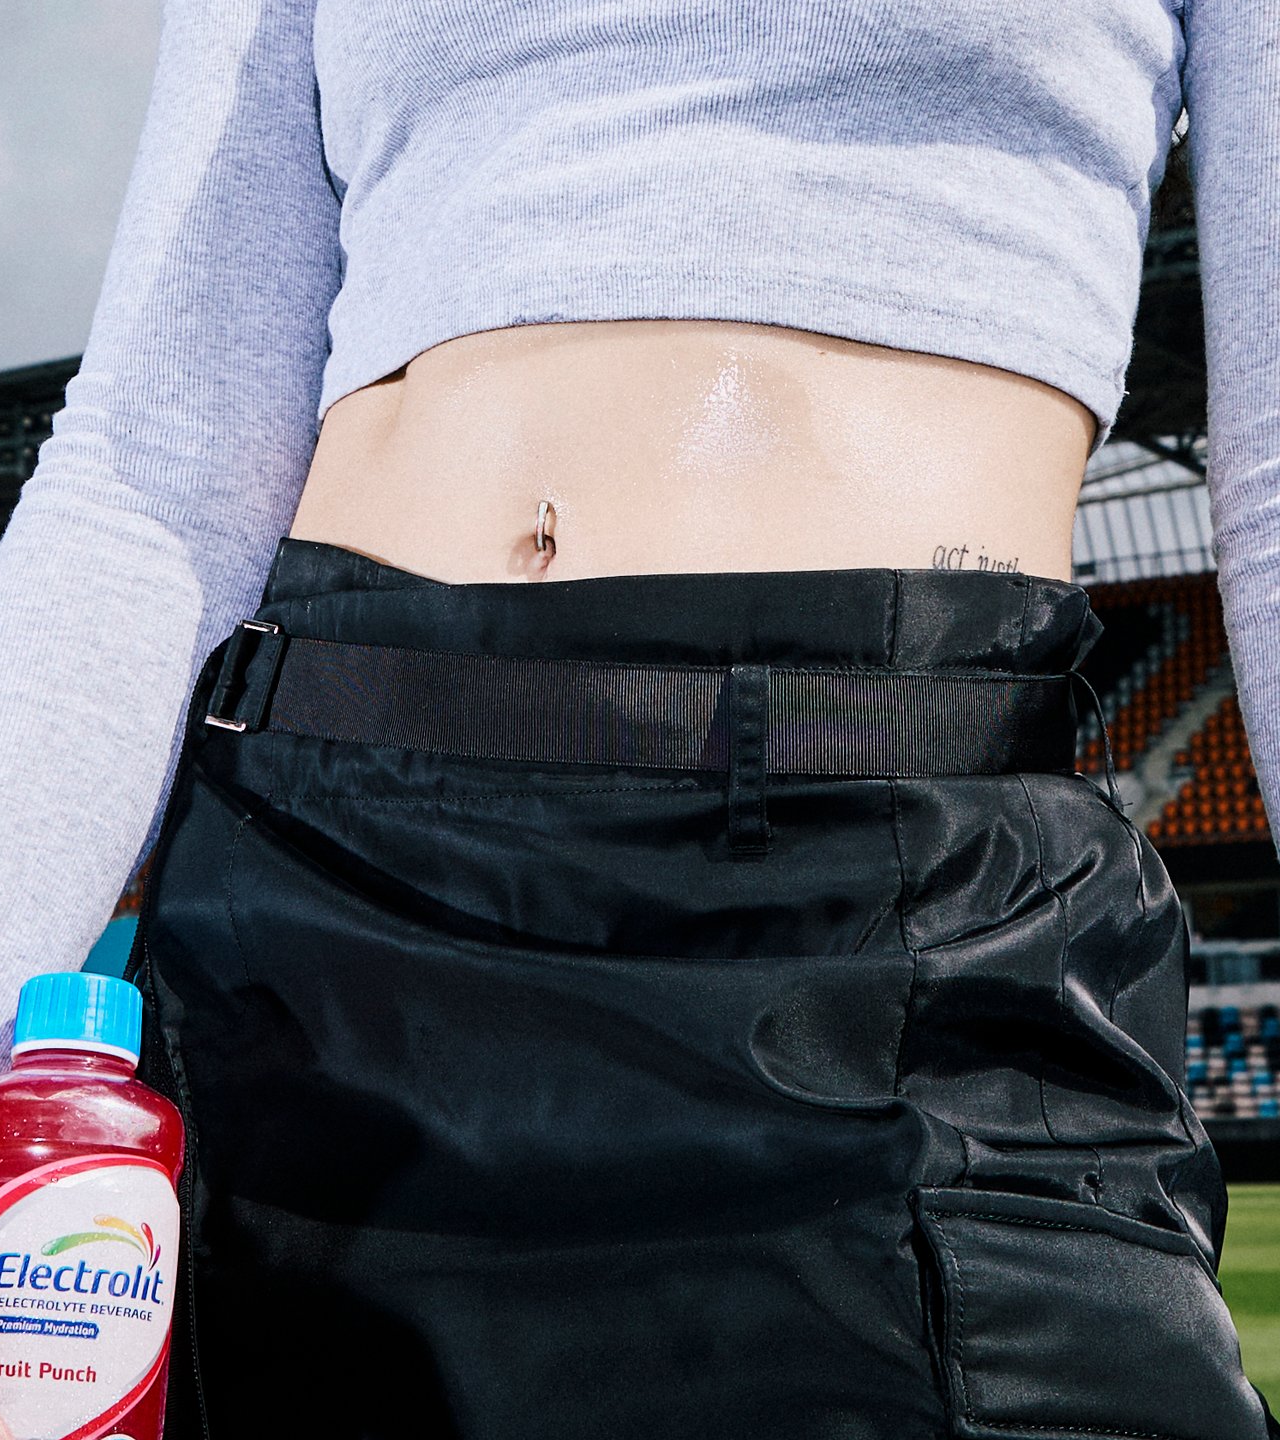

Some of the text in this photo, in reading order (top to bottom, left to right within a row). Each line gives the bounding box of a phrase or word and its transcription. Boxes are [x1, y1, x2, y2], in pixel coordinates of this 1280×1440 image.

[90, 1303, 153, 1322] BEVERAGE
[43, 1321, 95, 1337] Hydration
[38, 1362, 97, 1383] Punch
